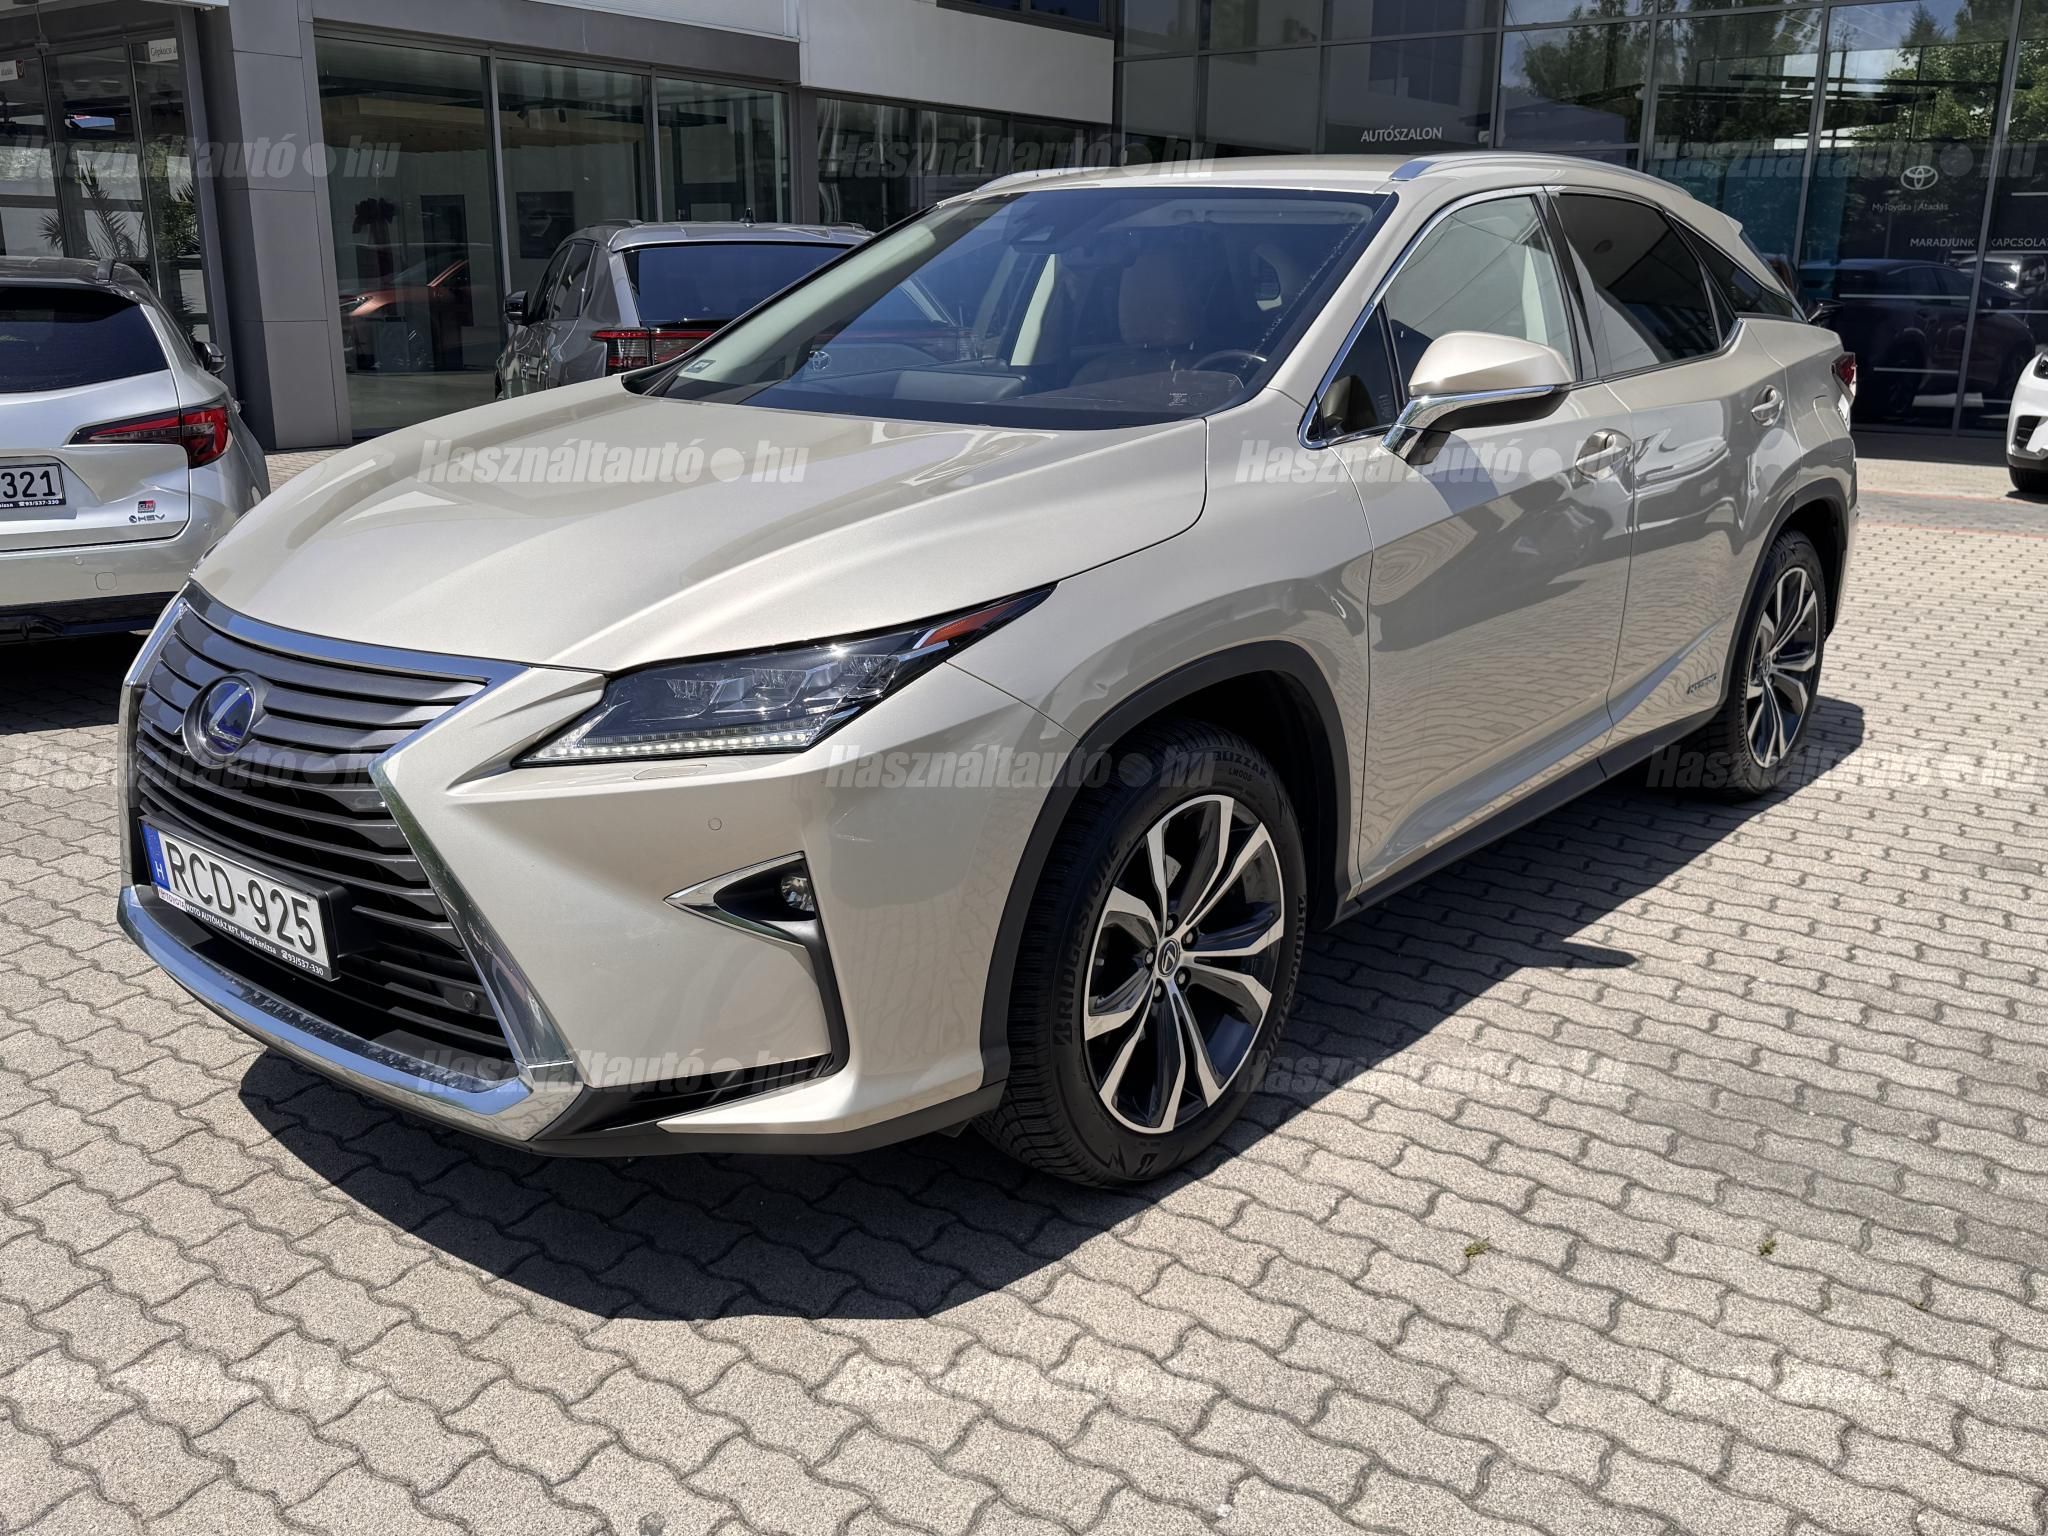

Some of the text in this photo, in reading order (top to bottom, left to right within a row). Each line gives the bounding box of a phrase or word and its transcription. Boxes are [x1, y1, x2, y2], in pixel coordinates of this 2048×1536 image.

[1361, 125, 1443, 142] AUTÓSZALON
[1872, 203, 1912, 213] MyToyota
[1910, 238, 1976, 248] MARADJUNK
[165, 840, 316, 953] RCD-925
